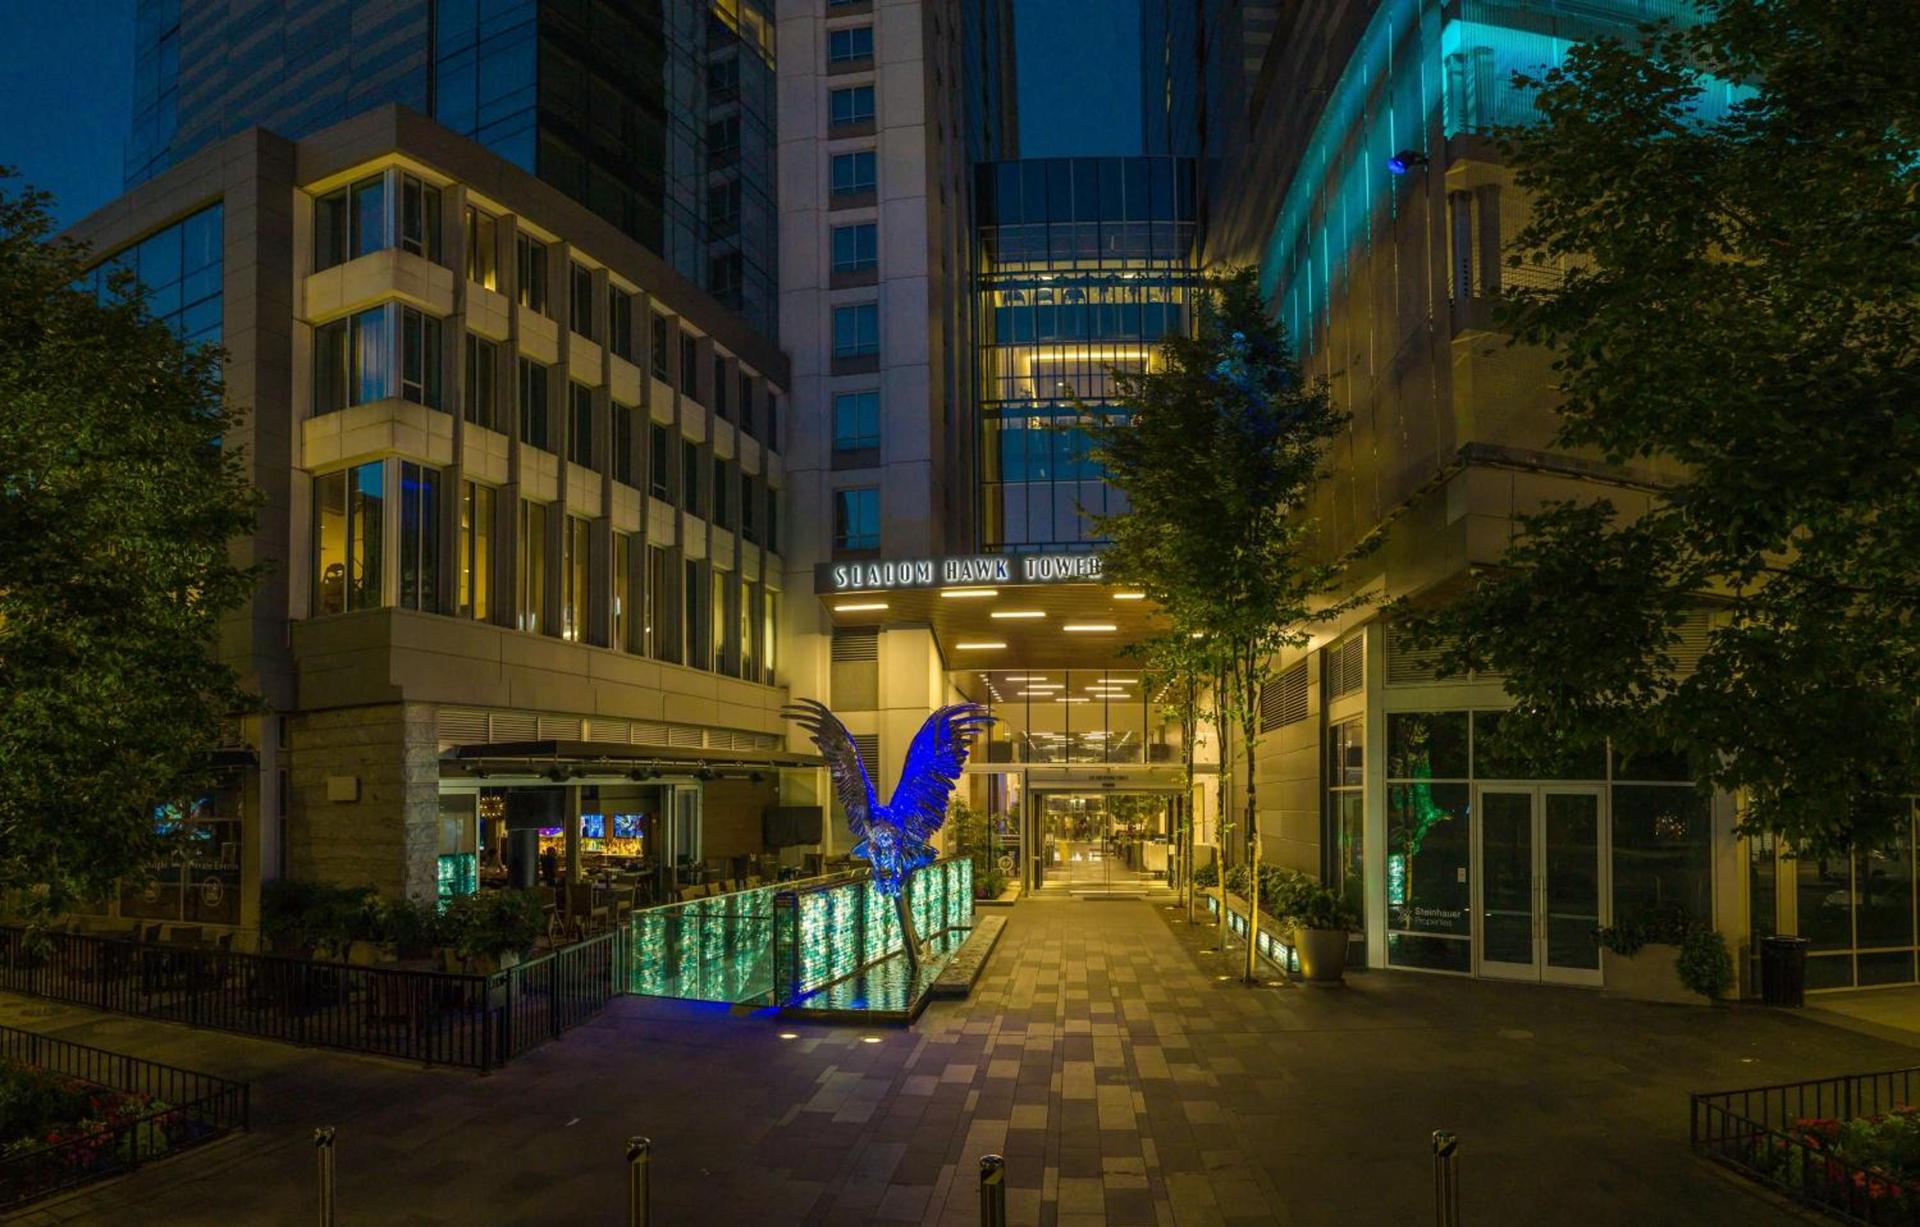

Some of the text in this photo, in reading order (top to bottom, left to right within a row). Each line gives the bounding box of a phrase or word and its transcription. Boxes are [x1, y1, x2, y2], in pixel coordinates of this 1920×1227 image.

[834, 561, 933, 588] SLALOM
[945, 558, 1008, 582] HAWK
[1415, 906, 1461, 919] Steinhauer
